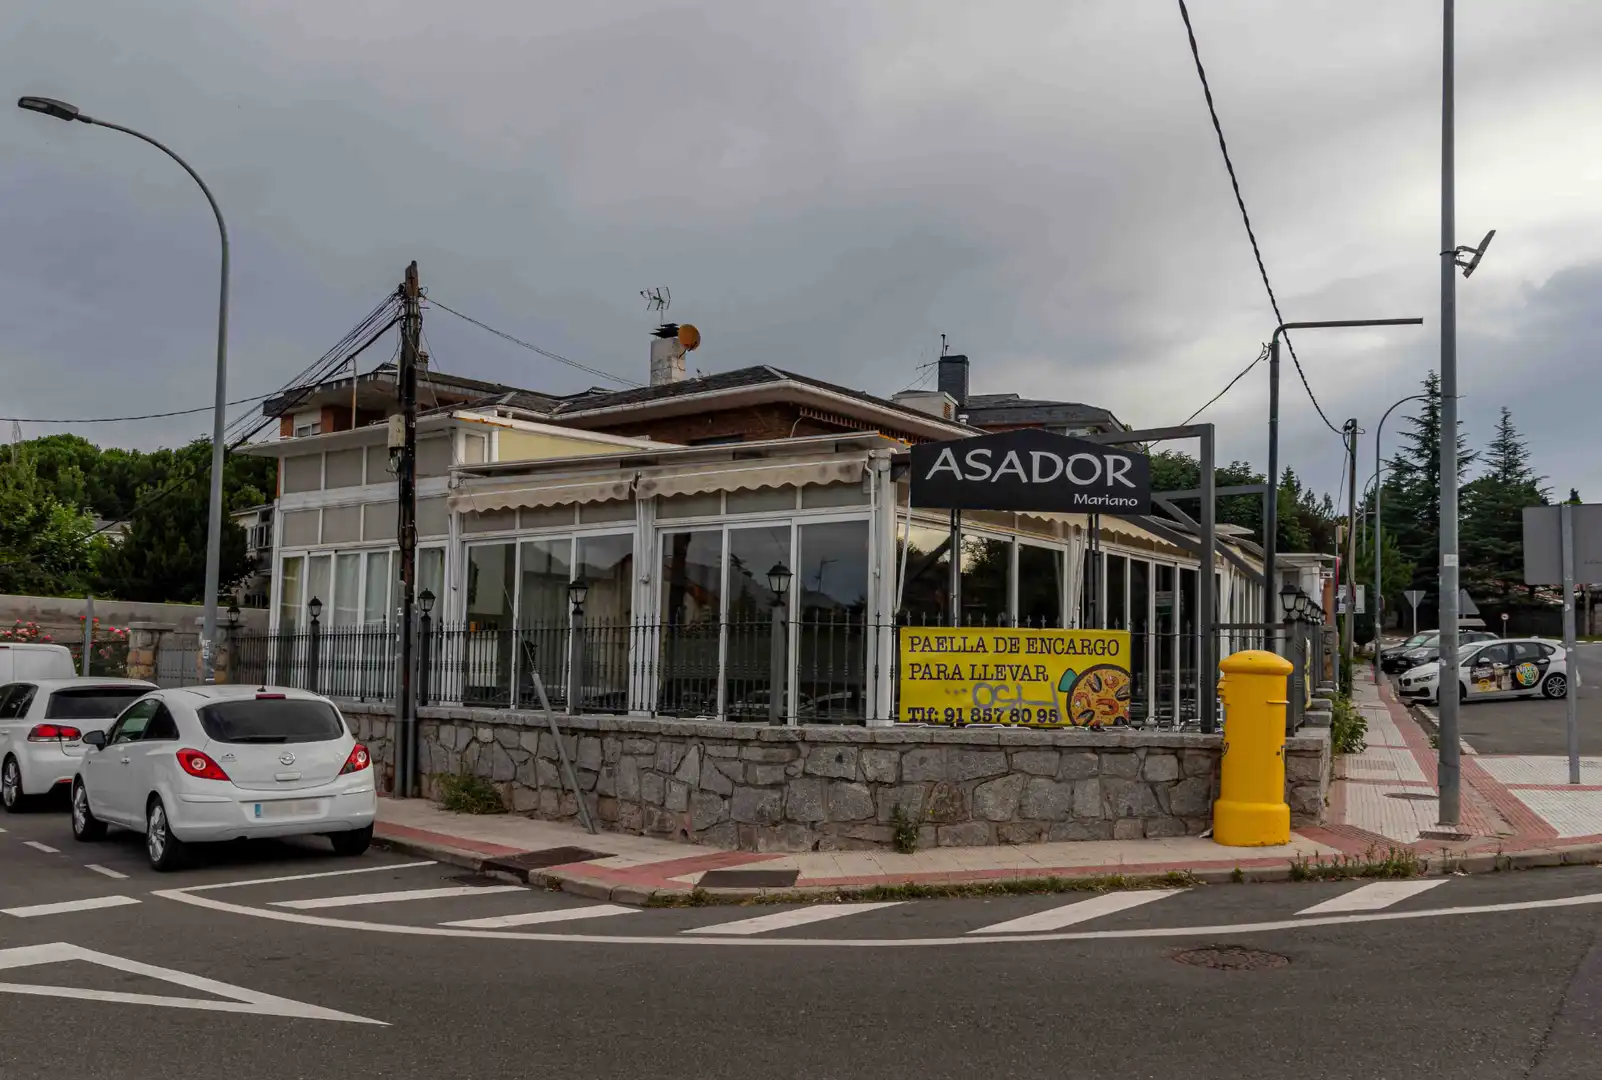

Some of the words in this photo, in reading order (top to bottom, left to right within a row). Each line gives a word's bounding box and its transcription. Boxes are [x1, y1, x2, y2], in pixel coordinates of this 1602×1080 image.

[925, 448, 1136, 488] ASADOR
[1073, 493, 1138, 507] Mariano
[908, 636, 989, 653] PAELLA
[993, 637, 1020, 654] DE
[1025, 638, 1120, 656] ENCARGO
[908, 663, 965, 680] PARA
[969, 664, 1049, 682] LLEVAR
[943, 707, 965, 722] 91
[970, 707, 1005, 722] 857
[1009, 708, 1032, 723] 80
[1036, 709, 1059, 723] 95
